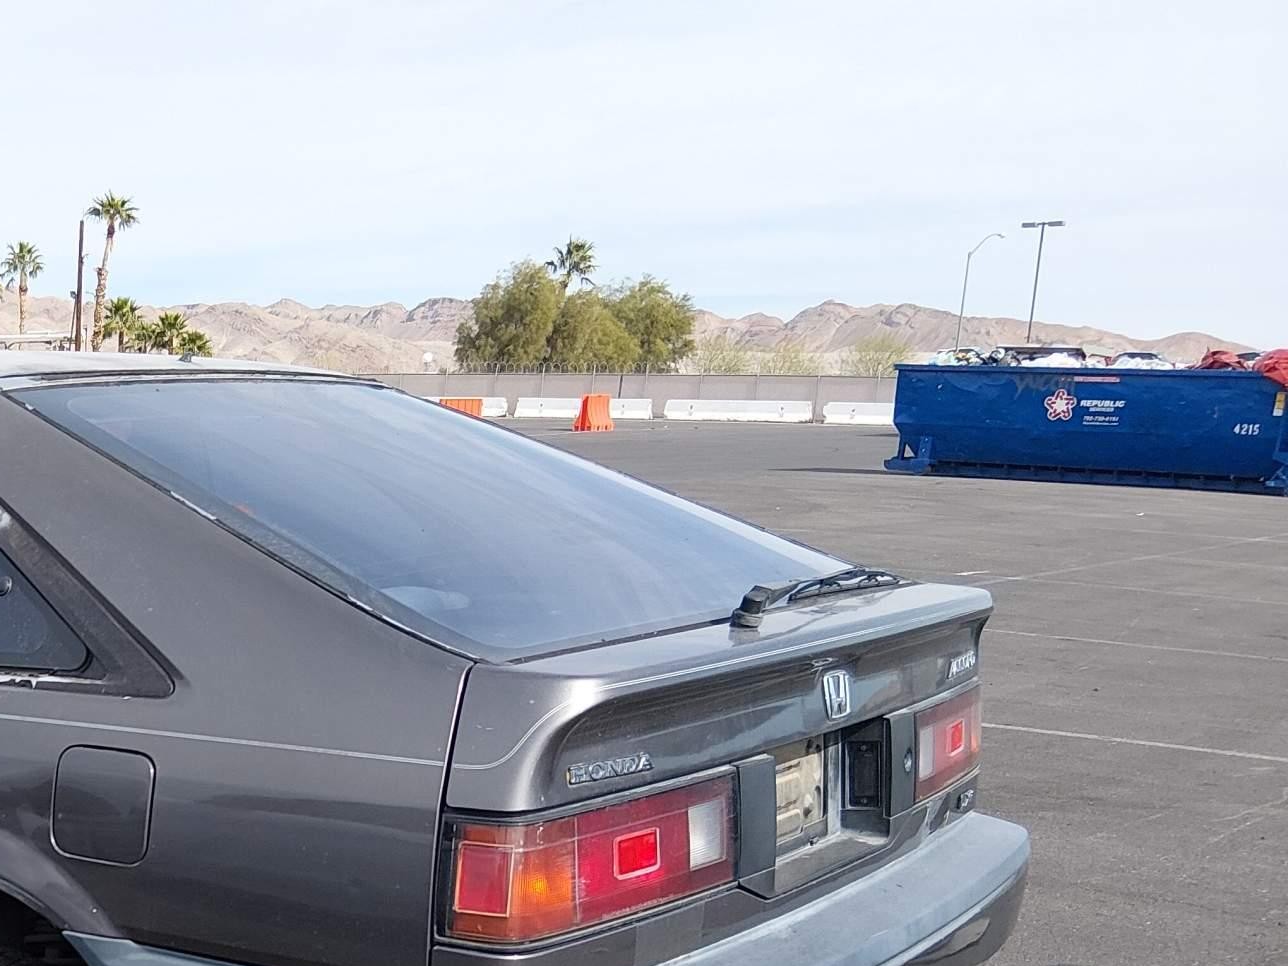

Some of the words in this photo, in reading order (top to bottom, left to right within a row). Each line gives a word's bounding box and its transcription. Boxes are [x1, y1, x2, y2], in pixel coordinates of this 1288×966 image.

[1080, 399, 1126, 408] REPUBLIC
[1233, 423, 1261, 436] 4215
[568, 752, 654, 785] HONDA
